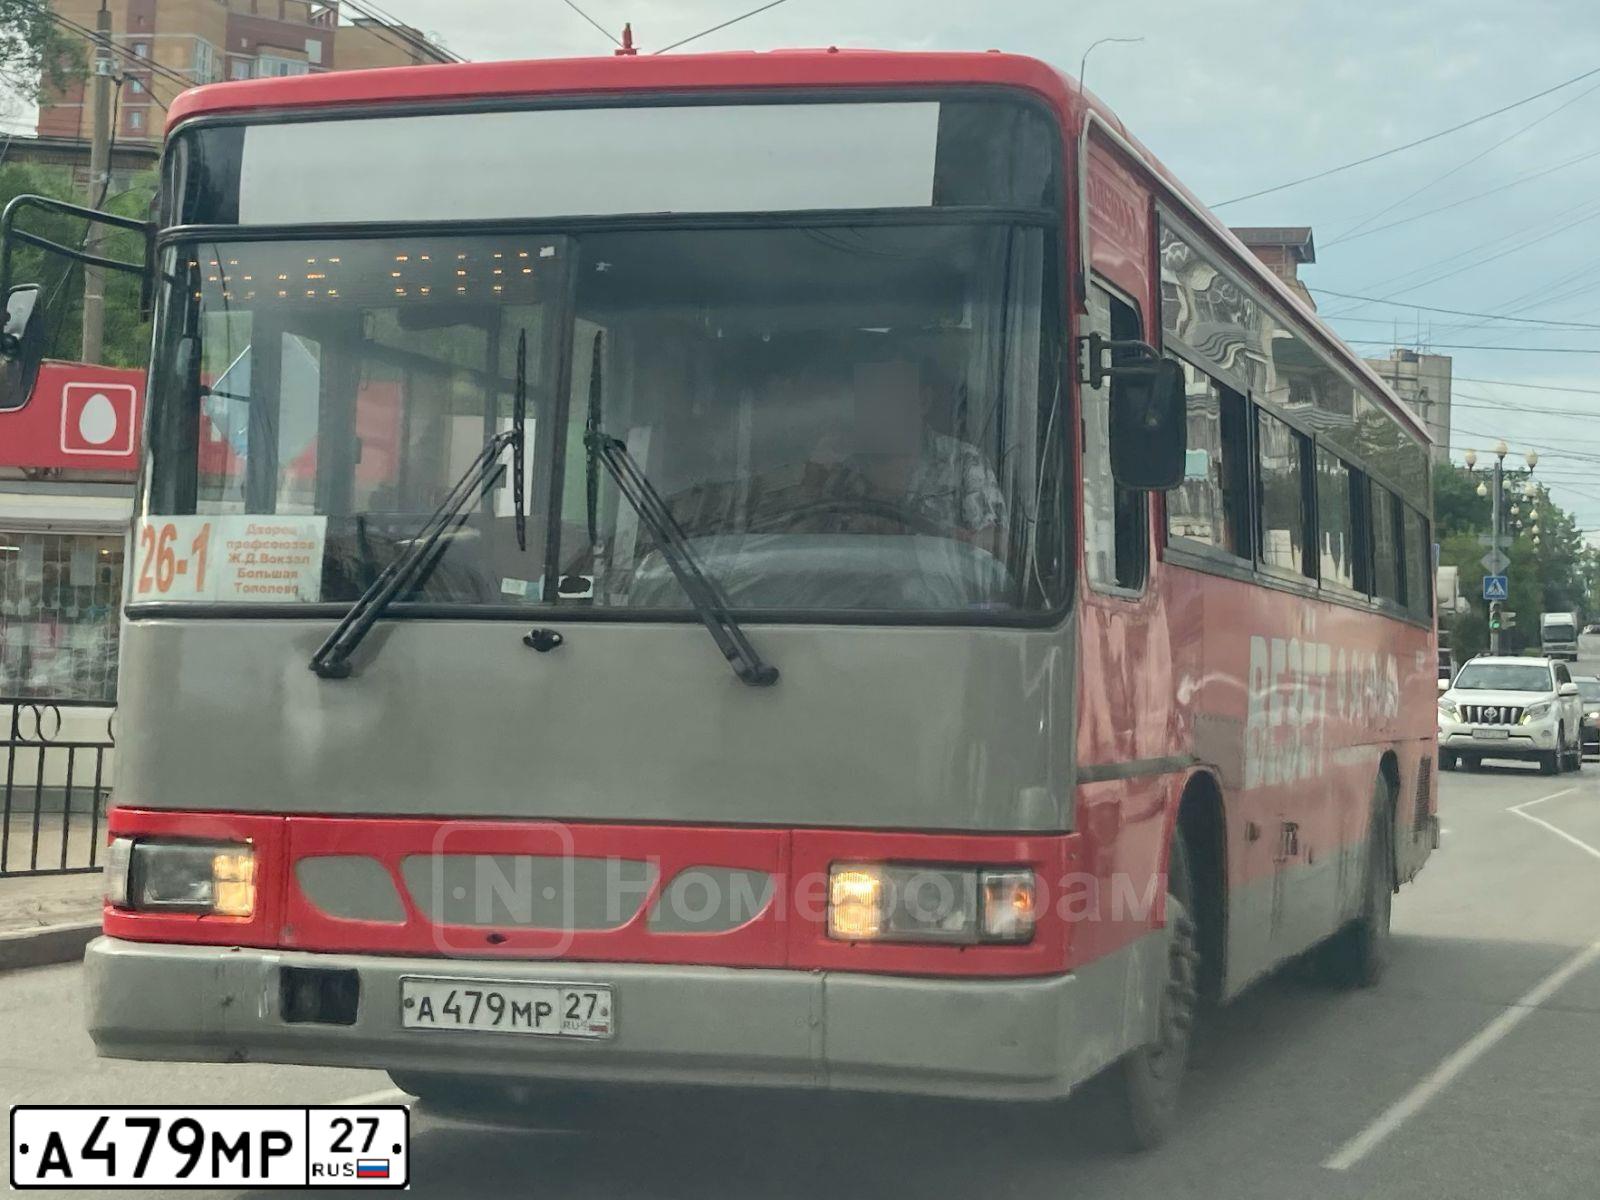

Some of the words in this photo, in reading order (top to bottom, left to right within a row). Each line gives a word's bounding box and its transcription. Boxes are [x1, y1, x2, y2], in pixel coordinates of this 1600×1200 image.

[138, 522, 211, 593] 26-1
[237, 567, 299, 579] Большая
[565, 992, 597, 1019] 27
